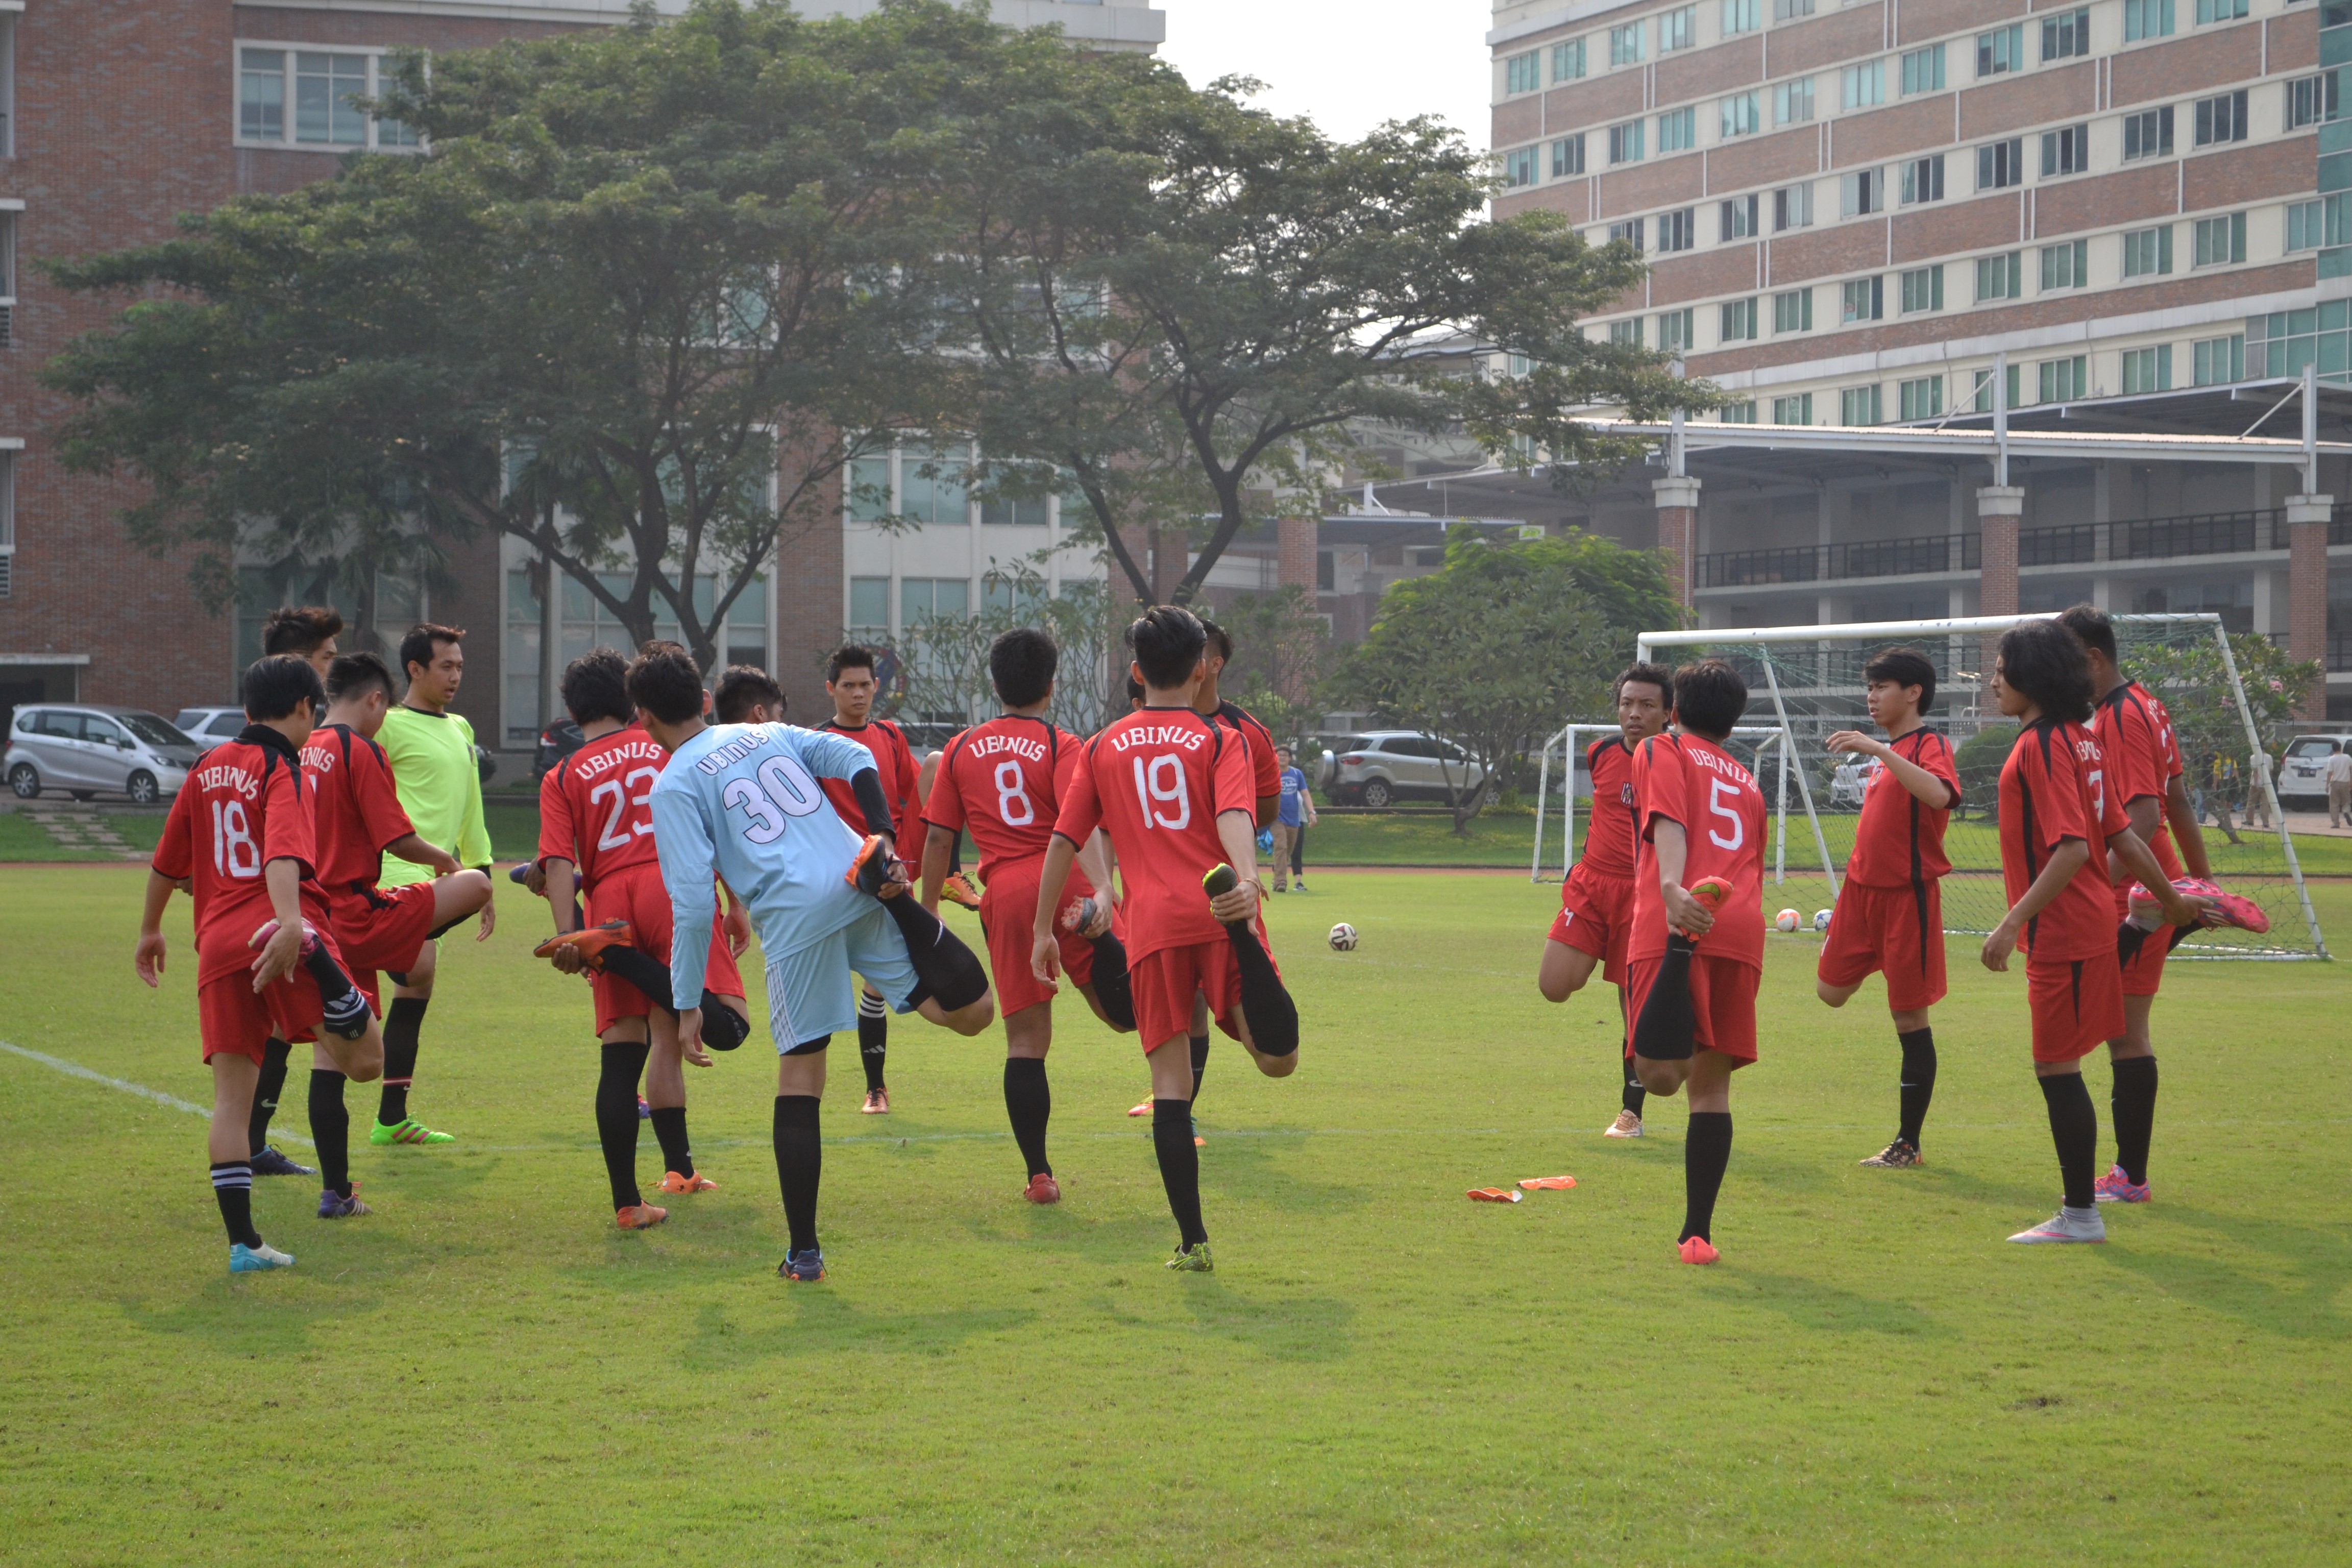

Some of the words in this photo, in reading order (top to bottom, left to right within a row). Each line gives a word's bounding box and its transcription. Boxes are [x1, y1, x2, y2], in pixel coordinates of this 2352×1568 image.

[575, 742, 663, 779] UBINUS
[696, 730, 769, 775] UBINUS
[969, 735, 1046, 762] UBINUS
[1111, 726, 1206, 751] UBINUS
[1686, 748, 1757, 793] UBINUS
[591, 766, 660, 852] 23
[722, 755, 823, 844] 30
[994, 760, 1034, 825] 8
[1133, 753, 1190, 829] 19
[1709, 776, 1743, 851] 5
[212, 800, 260, 877] 18
